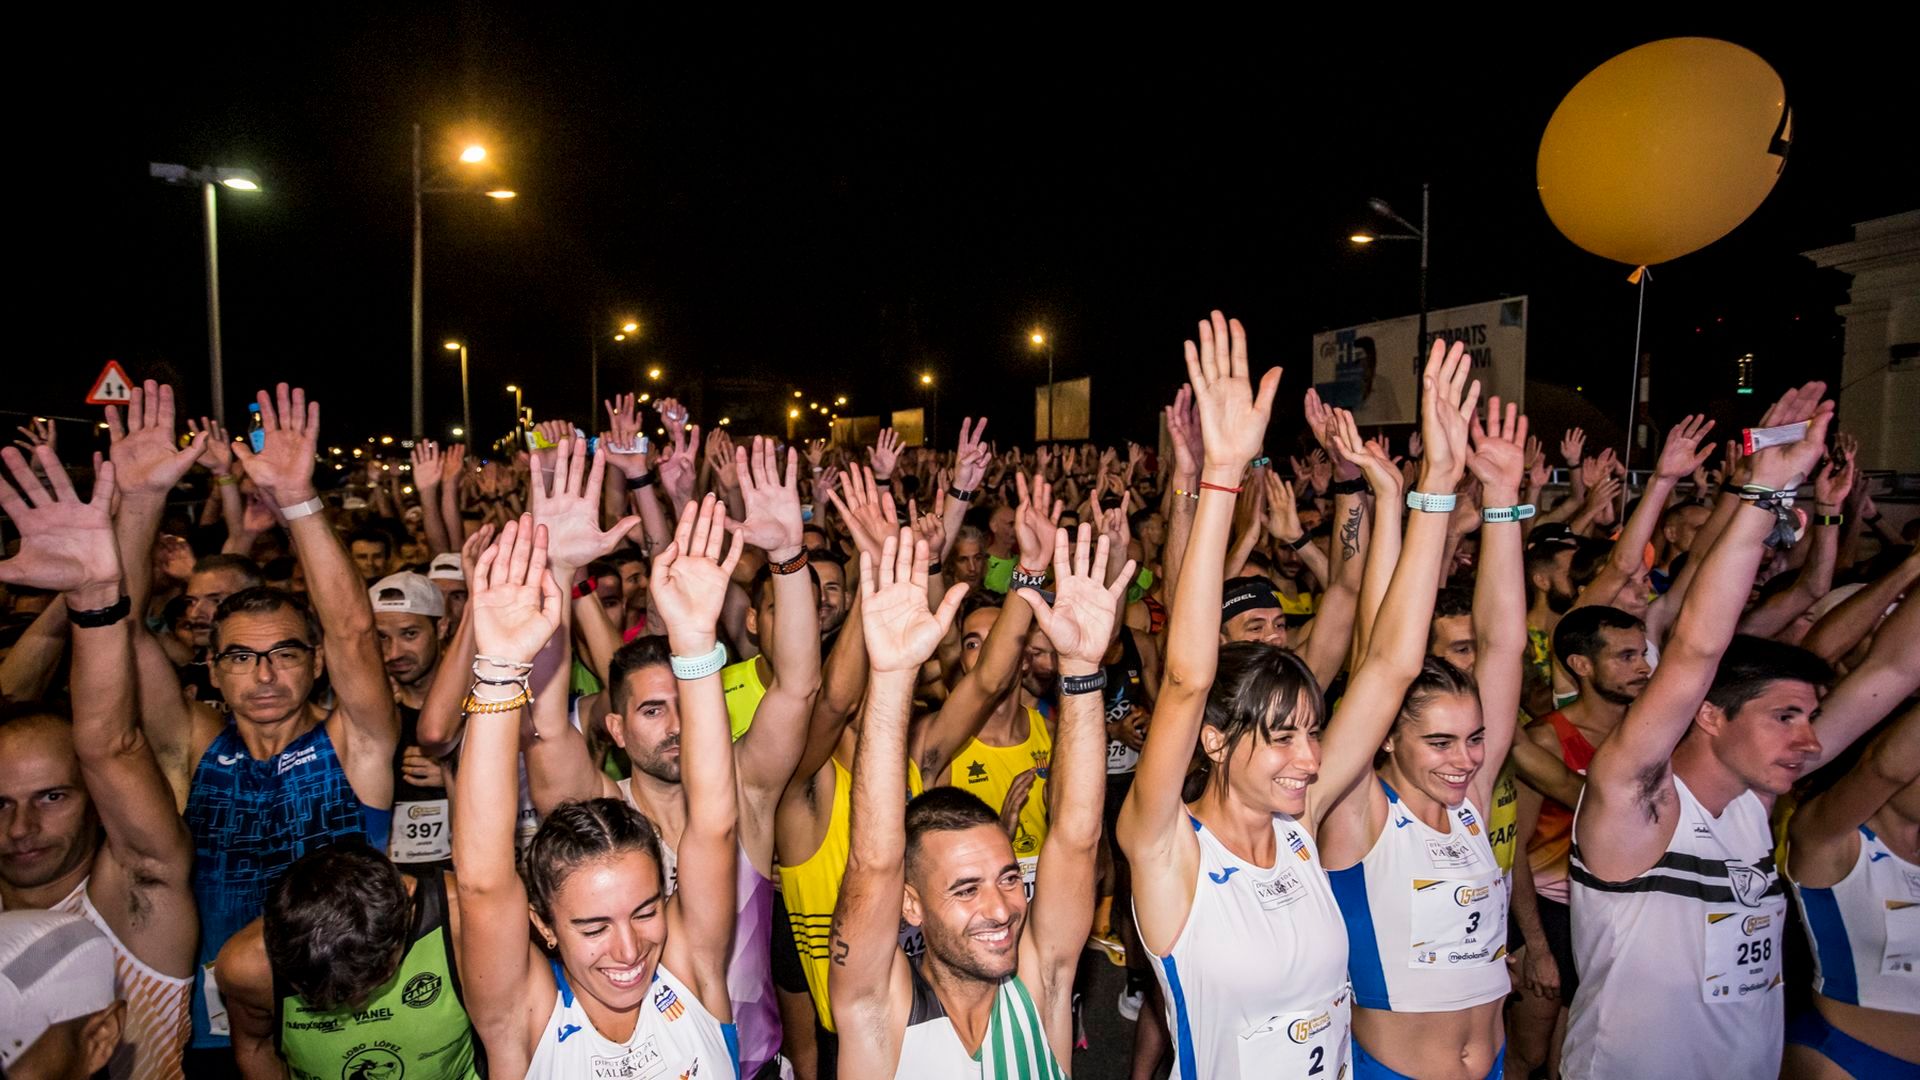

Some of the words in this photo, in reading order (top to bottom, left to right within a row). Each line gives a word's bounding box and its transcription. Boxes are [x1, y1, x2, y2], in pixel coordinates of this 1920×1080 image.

[407, 822, 442, 839] 397
[1465, 911, 1480, 934] 3
[1737, 937, 1771, 966] 258
[403, 979, 440, 1001] CANET
[352, 1008, 394, 1022] VANEL
[342, 1043, 367, 1060] LOBO
[374, 1040, 402, 1053] LÓPEZ
[1308, 1045, 1324, 1077] 2
